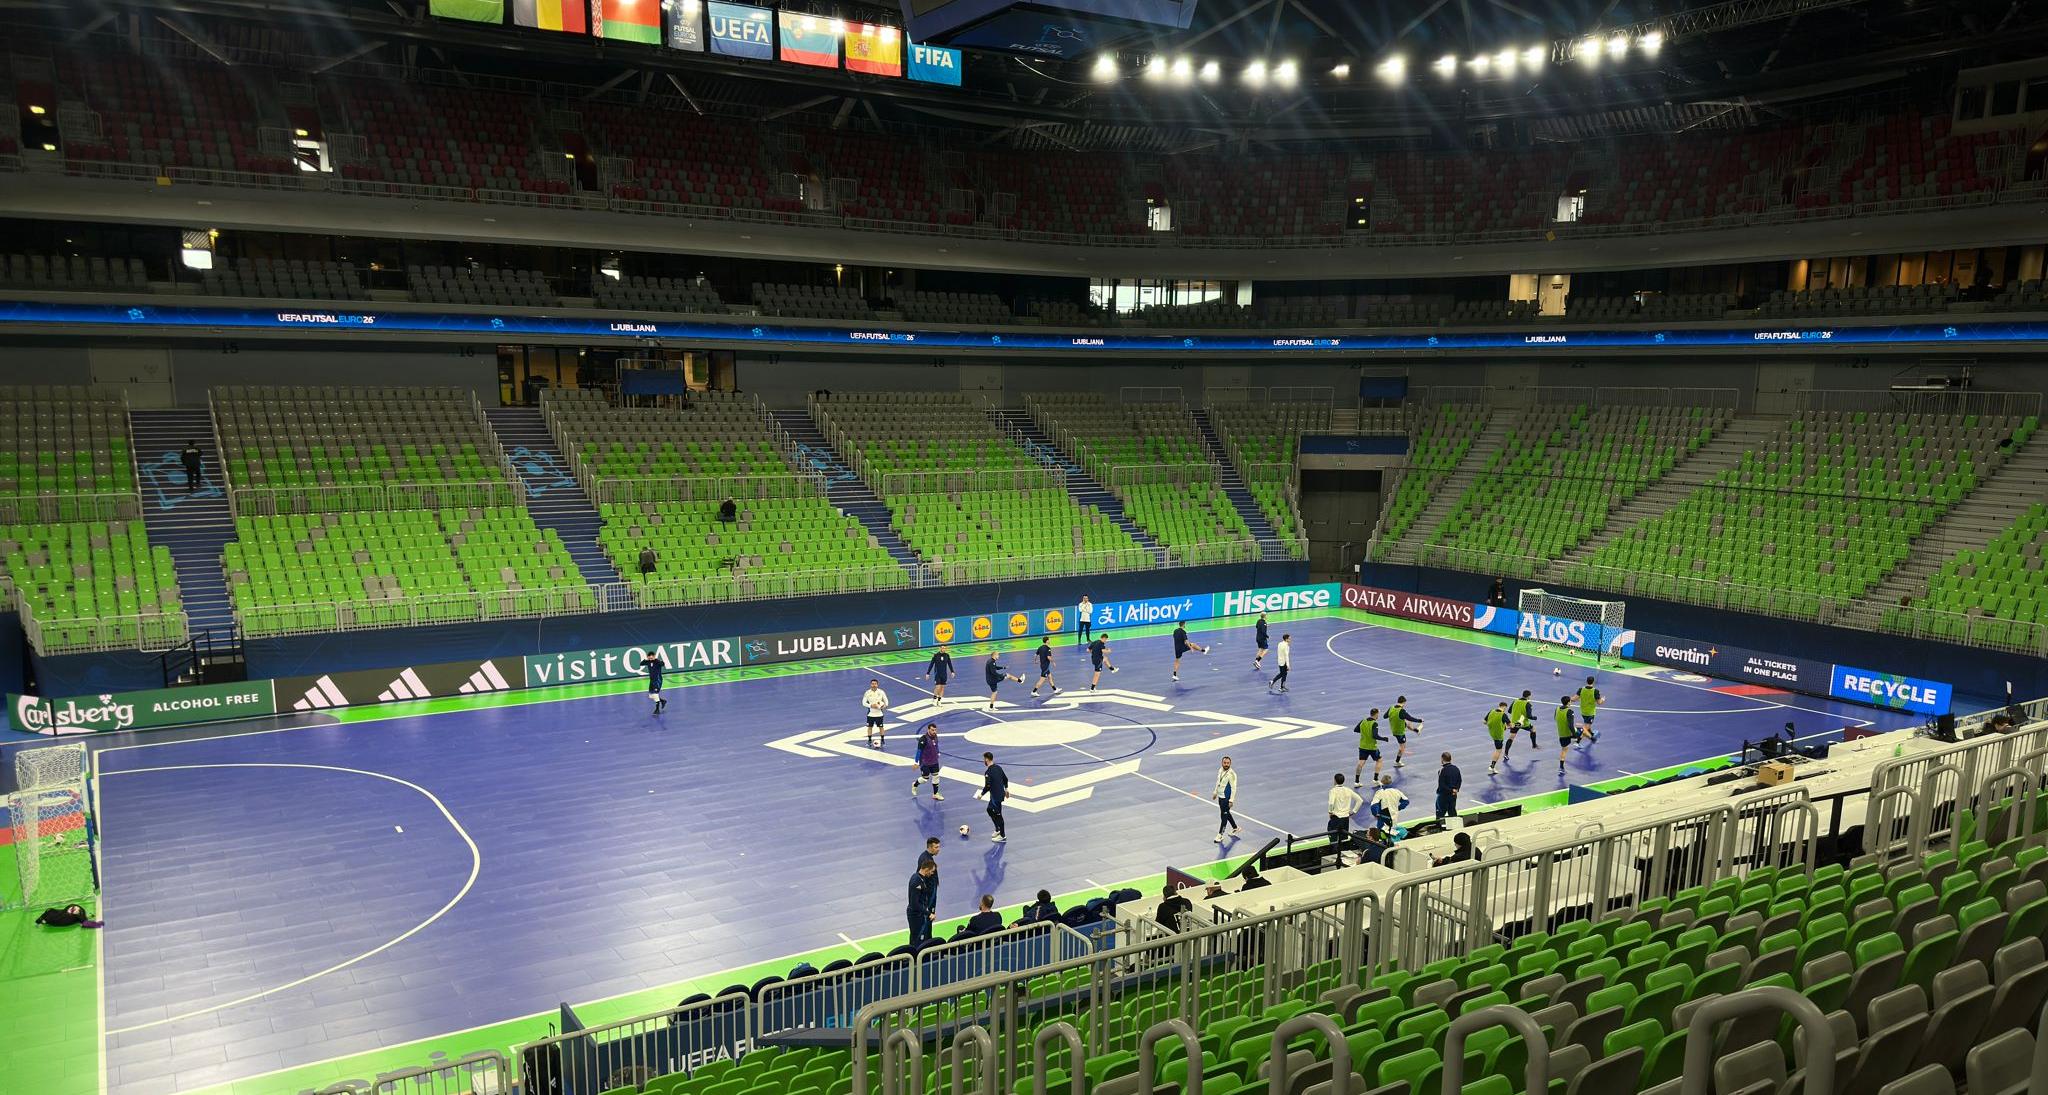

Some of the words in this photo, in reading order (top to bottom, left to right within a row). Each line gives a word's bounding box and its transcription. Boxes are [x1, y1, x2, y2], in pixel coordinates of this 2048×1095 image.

[711, 16, 770, 43] UEFA
[914, 46, 954, 69] FIFA
[277, 313, 302, 322] UEFA
[302, 314, 338, 323] FUTSAL
[610, 323, 657, 332] LJUBLJANA
[867, 332, 890, 340] FUTSAL
[1072, 338, 1104, 346] LJUBLJANA
[1754, 332, 1773, 340] UEFA
[1773, 332, 1801, 340] FUTSAL
[1223, 588, 1330, 616] Hisense
[1345, 587, 1397, 610] QATAR
[1402, 596, 1471, 623] AIRWAYS
[1518, 612, 1585, 648] Atos
[778, 631, 887, 655] LJUBLJANA
[534, 650, 618, 683] visit
[622, 640, 731, 676] QATAR
[1656, 645, 1710, 666] eventim
[1748, 657, 1764, 666] ALL
[1764, 660, 1797, 672] TICKETS
[1753, 667, 1771, 677] ONE
[1771, 671, 1798, 682] PLACE
[1844, 674, 1937, 705] RECYCLE
[18, 695, 134, 731] Carlsberg
[153, 697, 221, 712] ALCOHOL
[226, 693, 260, 705] FREE
